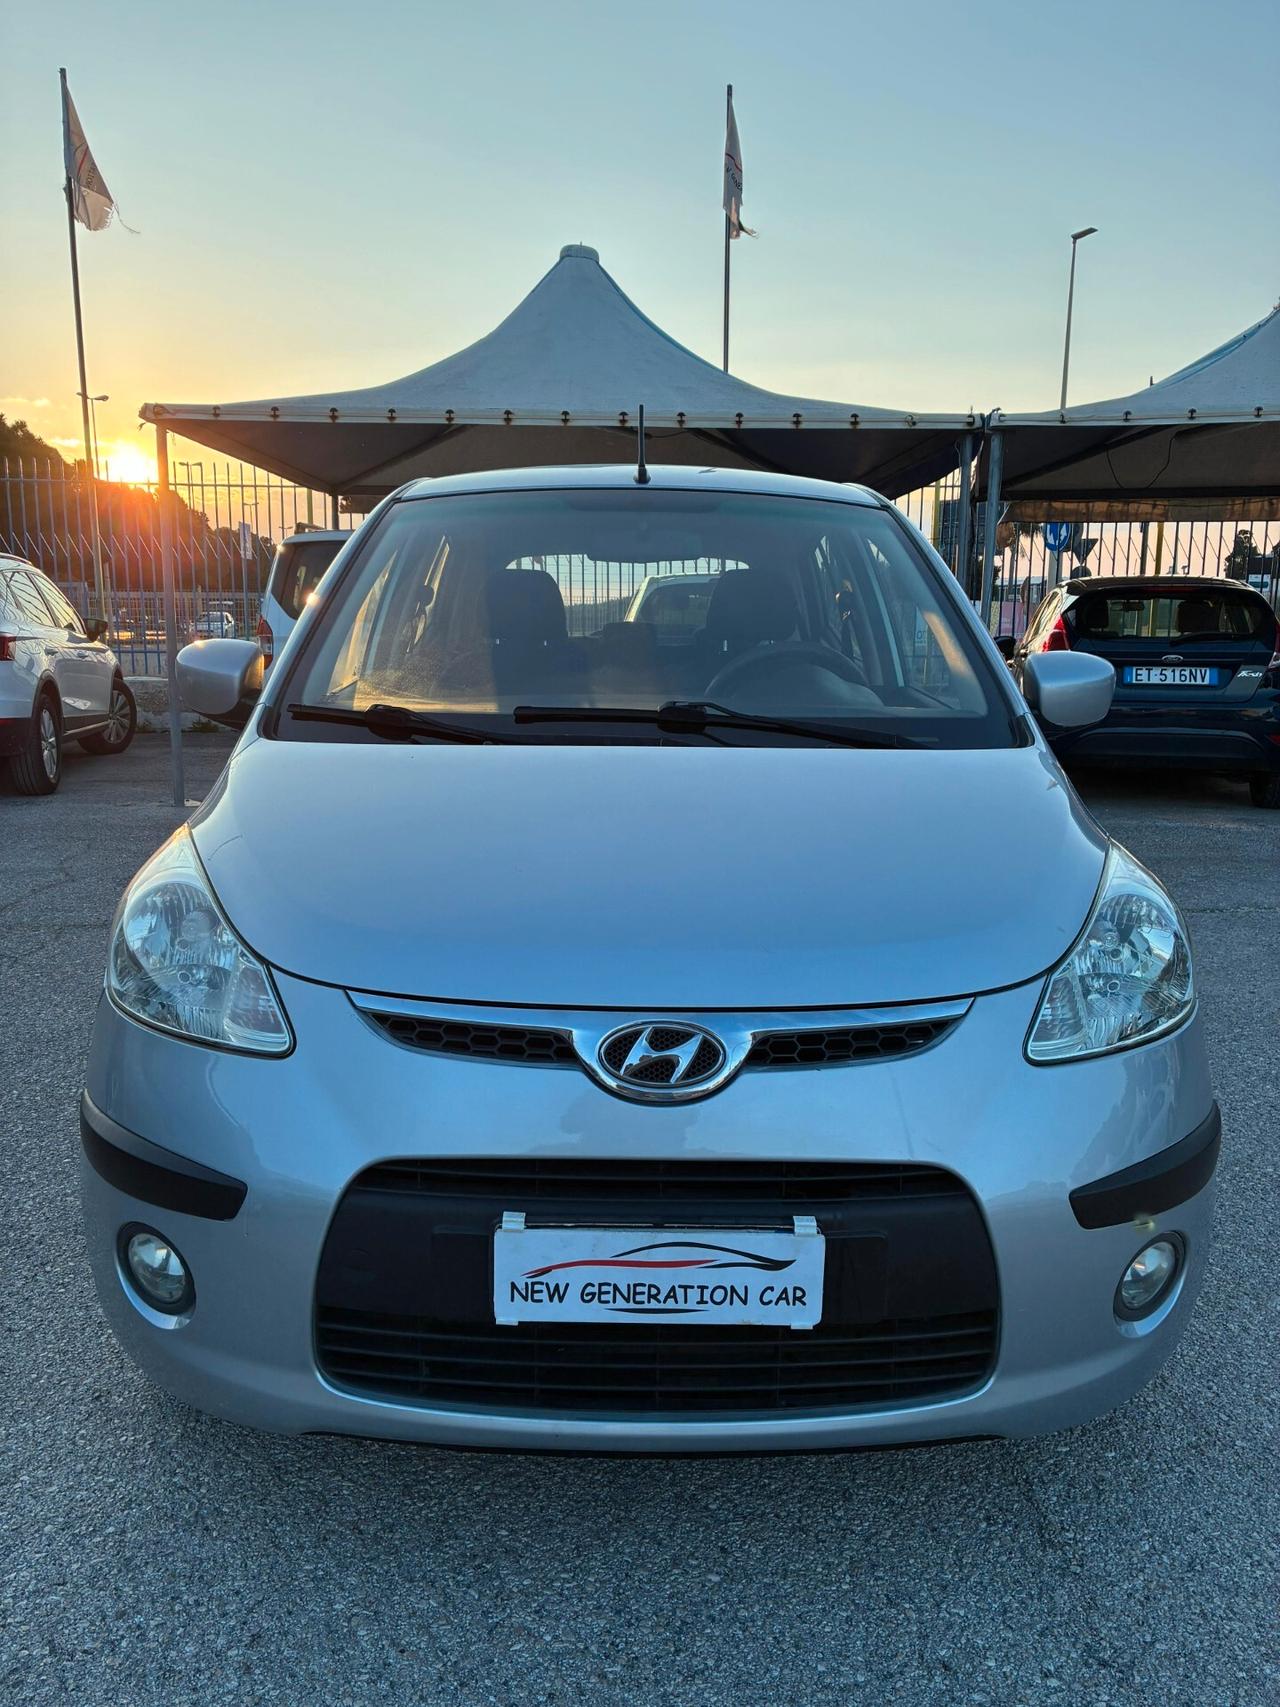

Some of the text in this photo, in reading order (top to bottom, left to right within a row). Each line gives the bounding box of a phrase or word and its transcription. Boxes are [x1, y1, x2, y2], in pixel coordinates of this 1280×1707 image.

[509, 1281, 807, 1307] NEW GENERATION CAR
